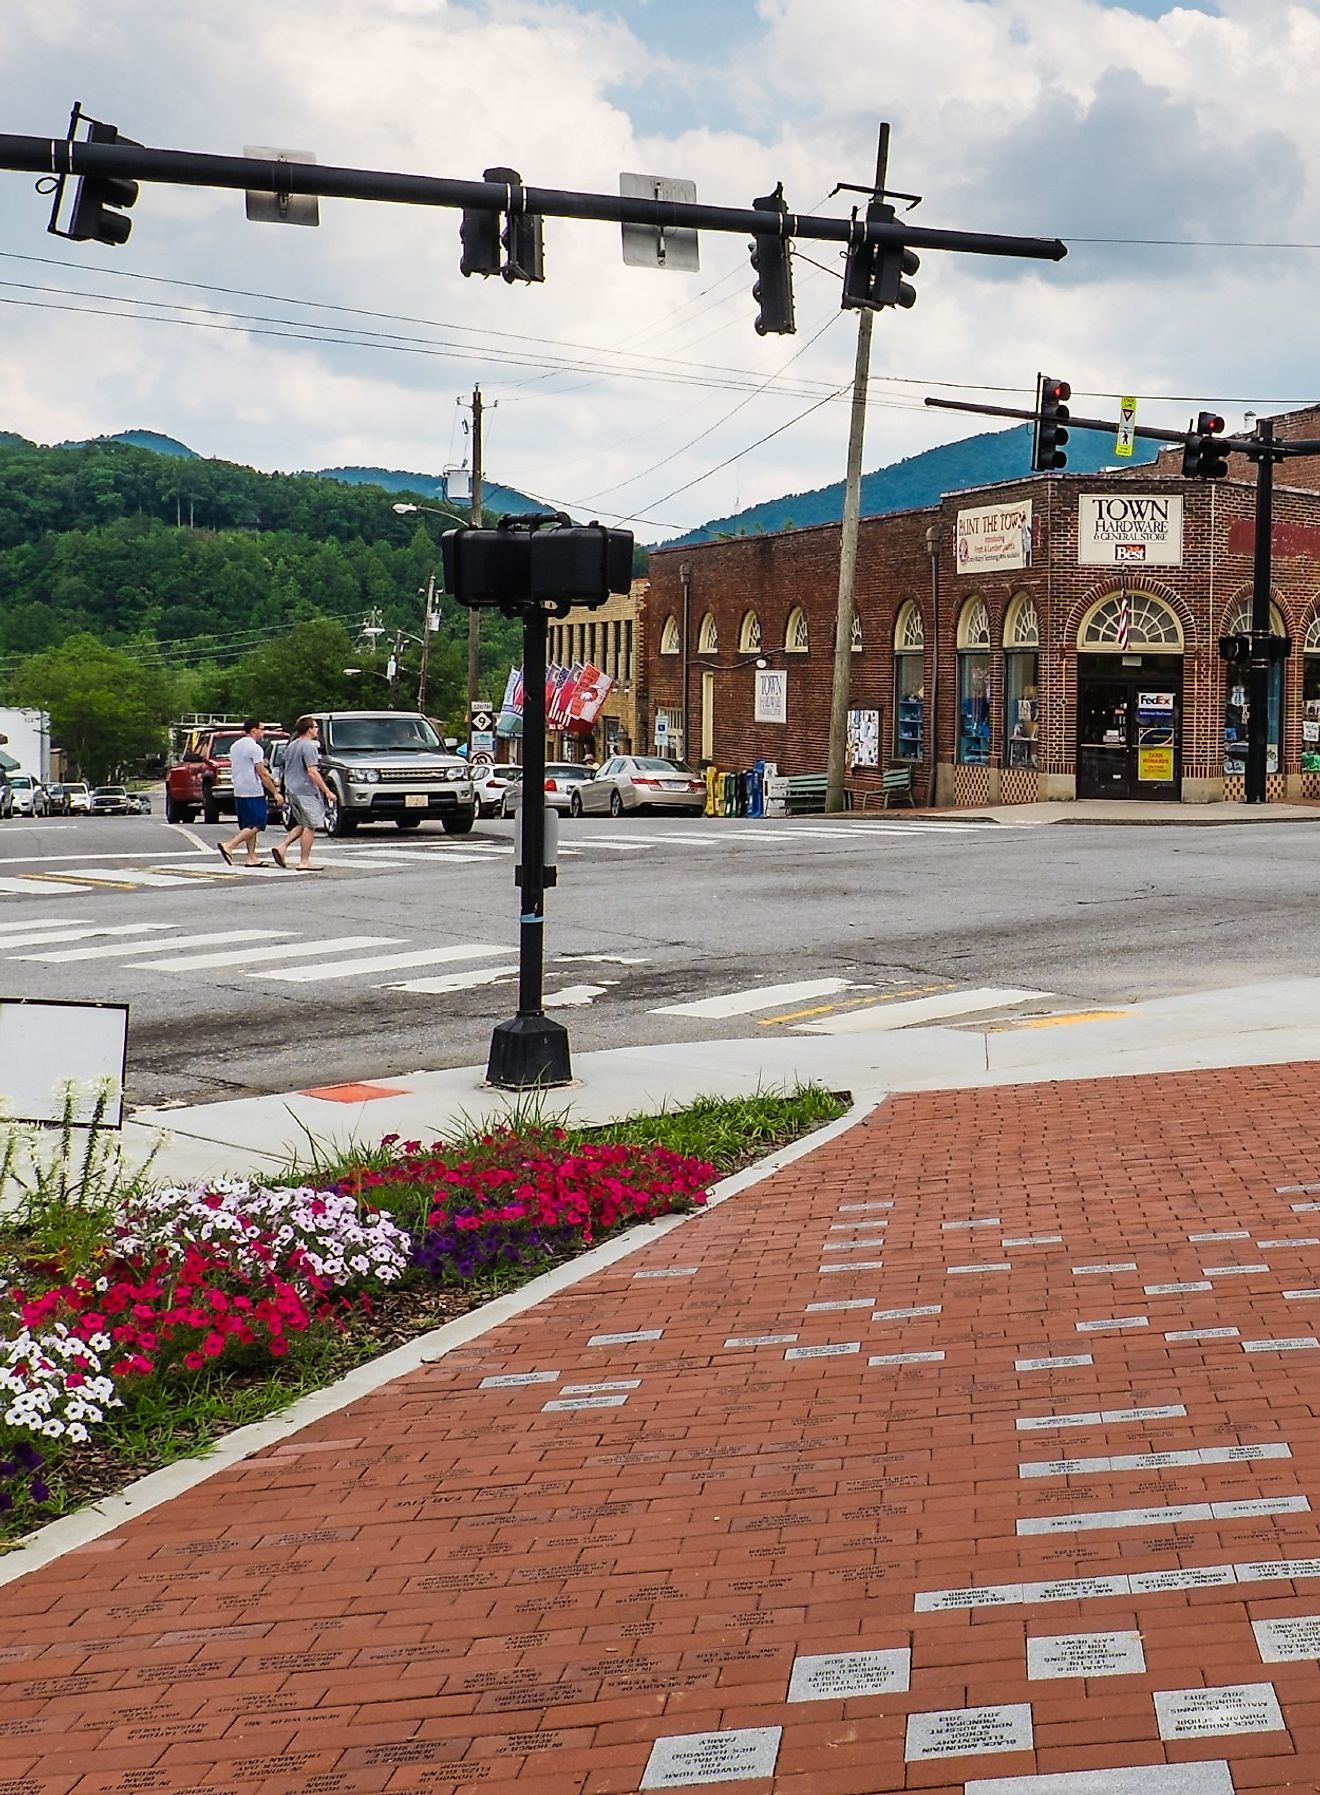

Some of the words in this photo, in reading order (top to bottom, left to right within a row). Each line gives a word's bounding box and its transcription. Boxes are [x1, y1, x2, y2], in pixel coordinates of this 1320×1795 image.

[1092, 499, 1168, 520] TOWN
[983, 515, 998, 533] THE
[1095, 521, 1168, 533] HARDWARE
[1141, 532, 1166, 540] STORE
[1117, 546, 1145, 560] Best
[761, 675, 782, 695] TOWN
[1141, 695, 1170, 705] FedEx
[479, 717, 485, 727] 9
[1192, 1698, 1241, 1706] PRINCIPAL
[1220, 1713, 1266, 1721] PRIMARY
[945, 1718, 996, 1727] PRINCIPAL
[1175, 1723, 1229, 1731] MOUNTAIN
[698, 1737, 737, 1745] FAMILY
[935, 1735, 1003, 1745] ELEMENTARY
[922, 1743, 978, 1753] MOUNTAIN
[671, 1749, 728, 1759] HARWOOD
[685, 1754, 740, 1764] FUNERALS
[249, 1768, 287, 1776] HONOR
[661, 1771, 694, 1779] HOME
[698, 1765, 755, 1777] HARWOOD
